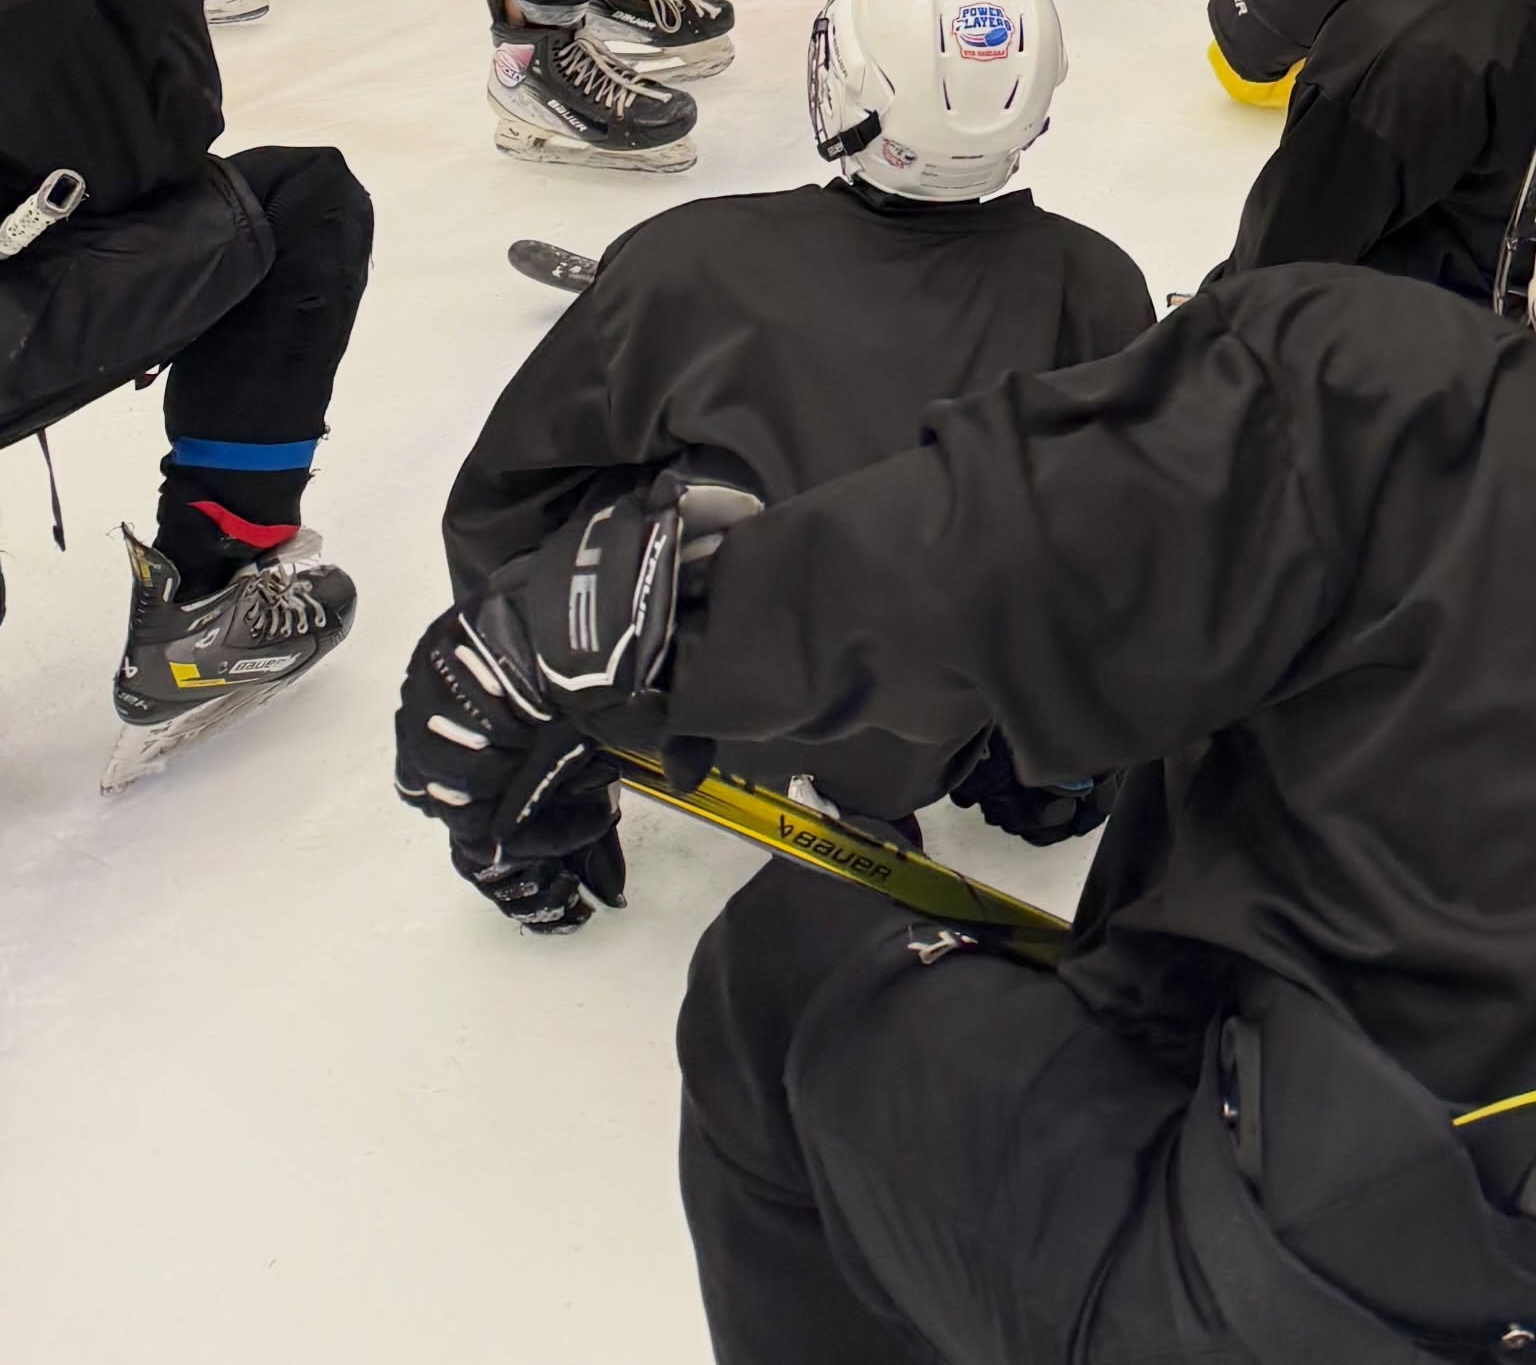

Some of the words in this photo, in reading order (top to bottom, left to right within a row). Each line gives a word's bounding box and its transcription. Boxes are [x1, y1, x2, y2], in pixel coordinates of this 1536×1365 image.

[961, 6, 1003, 19] POWER
[547, 98, 589, 133] BAUER
[794, 829, 892, 883] BAUER
